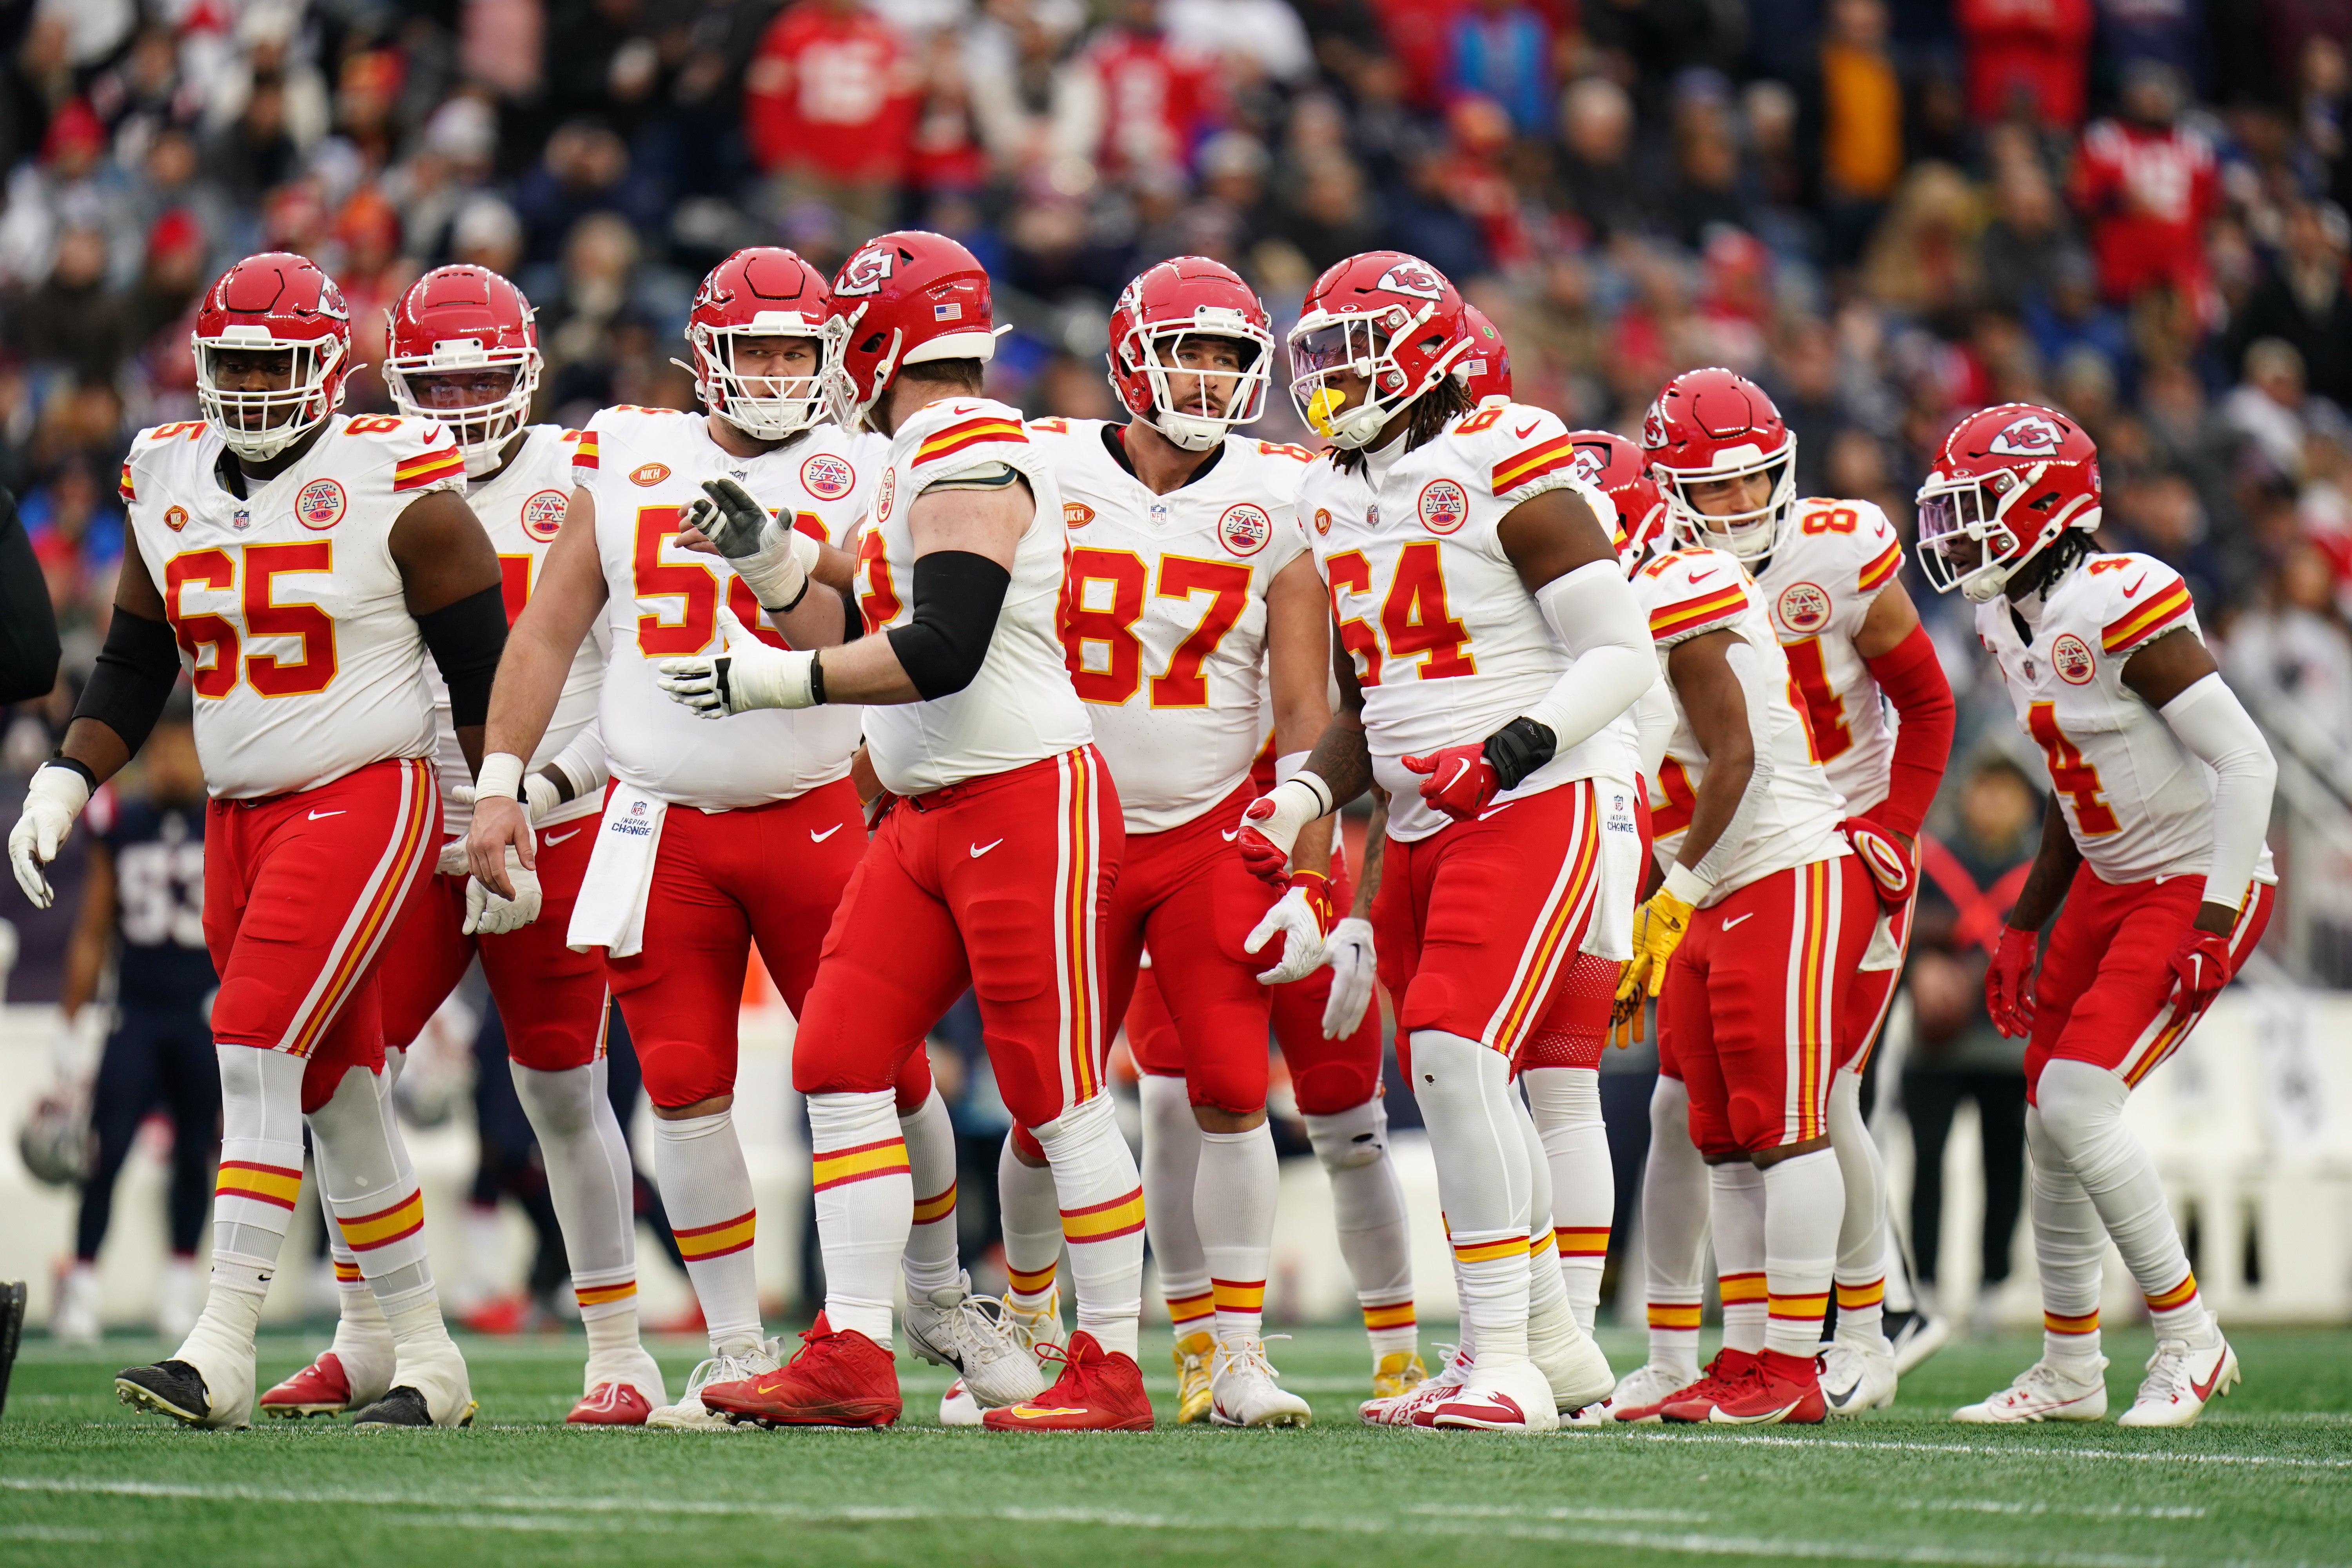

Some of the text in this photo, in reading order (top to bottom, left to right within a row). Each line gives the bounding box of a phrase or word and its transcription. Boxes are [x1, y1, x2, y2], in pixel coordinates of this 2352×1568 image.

[1388, 268, 1437, 291] KC
[2001, 424, 2053, 449] KC
[639, 468, 661, 481] NKH
[809, 459, 847, 484] A
[303, 484, 338, 512] A
[1426, 486, 1461, 514] A
[234, 518, 248, 528] NFL
[1151, 513, 1165, 521] NFL
[1226, 510, 1263, 539] A
[1367, 514, 1377, 524] NFL
[165, 539, 339, 700] 65
[1326, 540, 1477, 687] 64
[1064, 546, 1254, 709] 87
[2027, 701, 2123, 837] 4
[621, 817, 649, 826] INSPIRE
[632, 807, 643, 815] NFL
[1610, 814, 1628, 822] INSPIRE
[611, 822, 652, 836] CHANGE
